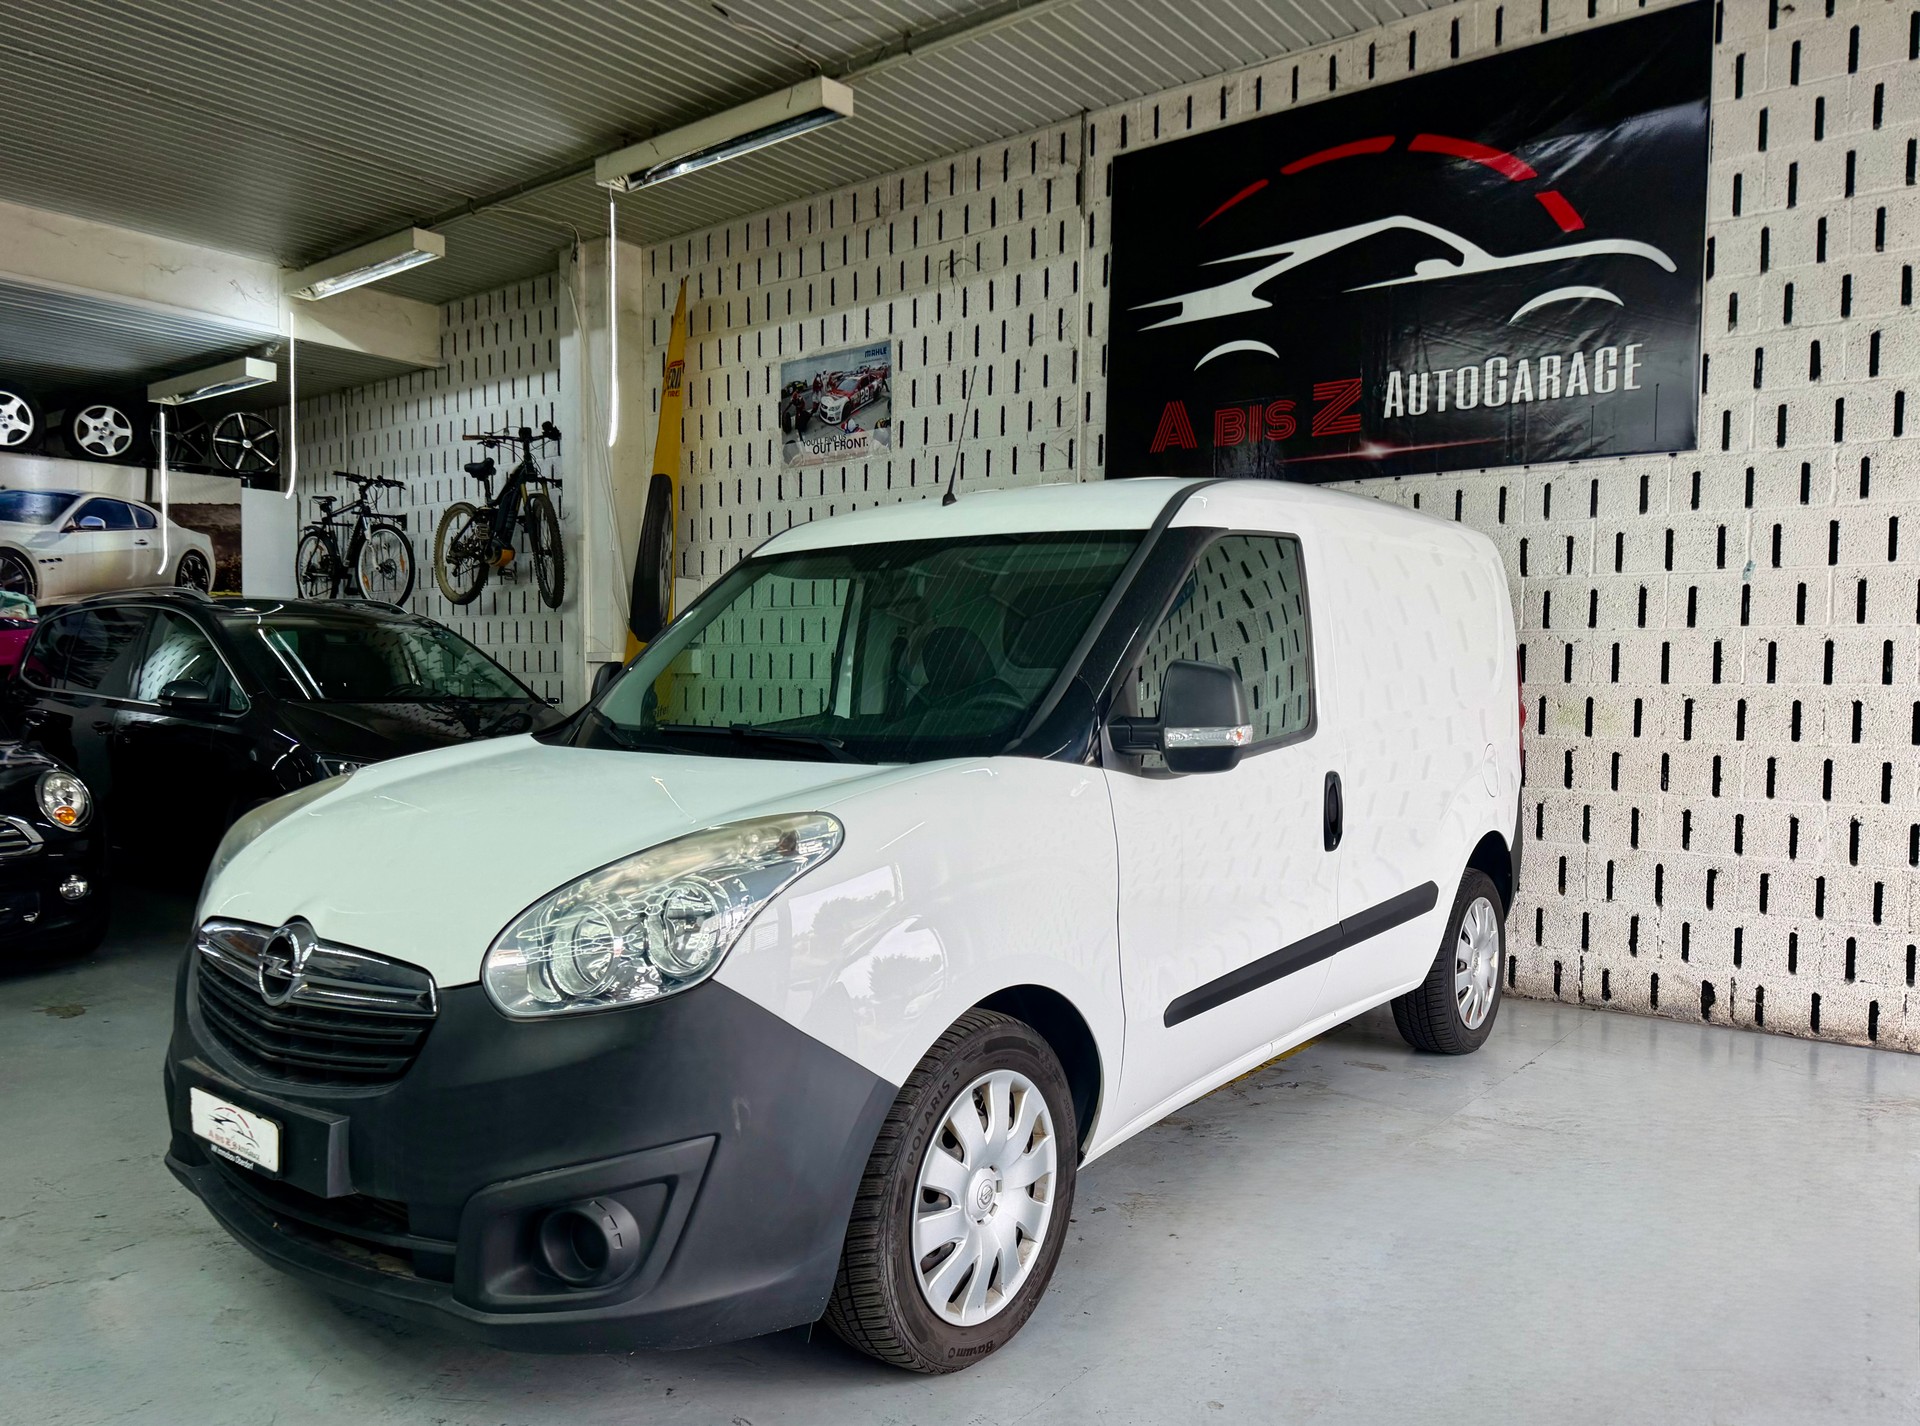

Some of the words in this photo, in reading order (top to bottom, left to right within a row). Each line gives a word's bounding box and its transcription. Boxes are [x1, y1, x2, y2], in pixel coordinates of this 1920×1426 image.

[865, 347, 887, 358] MAHLE
[860, 386, 870, 403] 29
[1150, 400, 1198, 453] A
[1214, 400, 1296, 447] BIS
[1312, 378, 1362, 437] Z
[1384, 343, 1643, 419] AUTOGARAGE
[813, 442, 831, 454] OUT
[834, 437, 868, 451] FRONT.
[907, 1081, 950, 1165] POLARIS
[952, 1068, 960, 1080] 5
[956, 1340, 996, 1357] Barum
